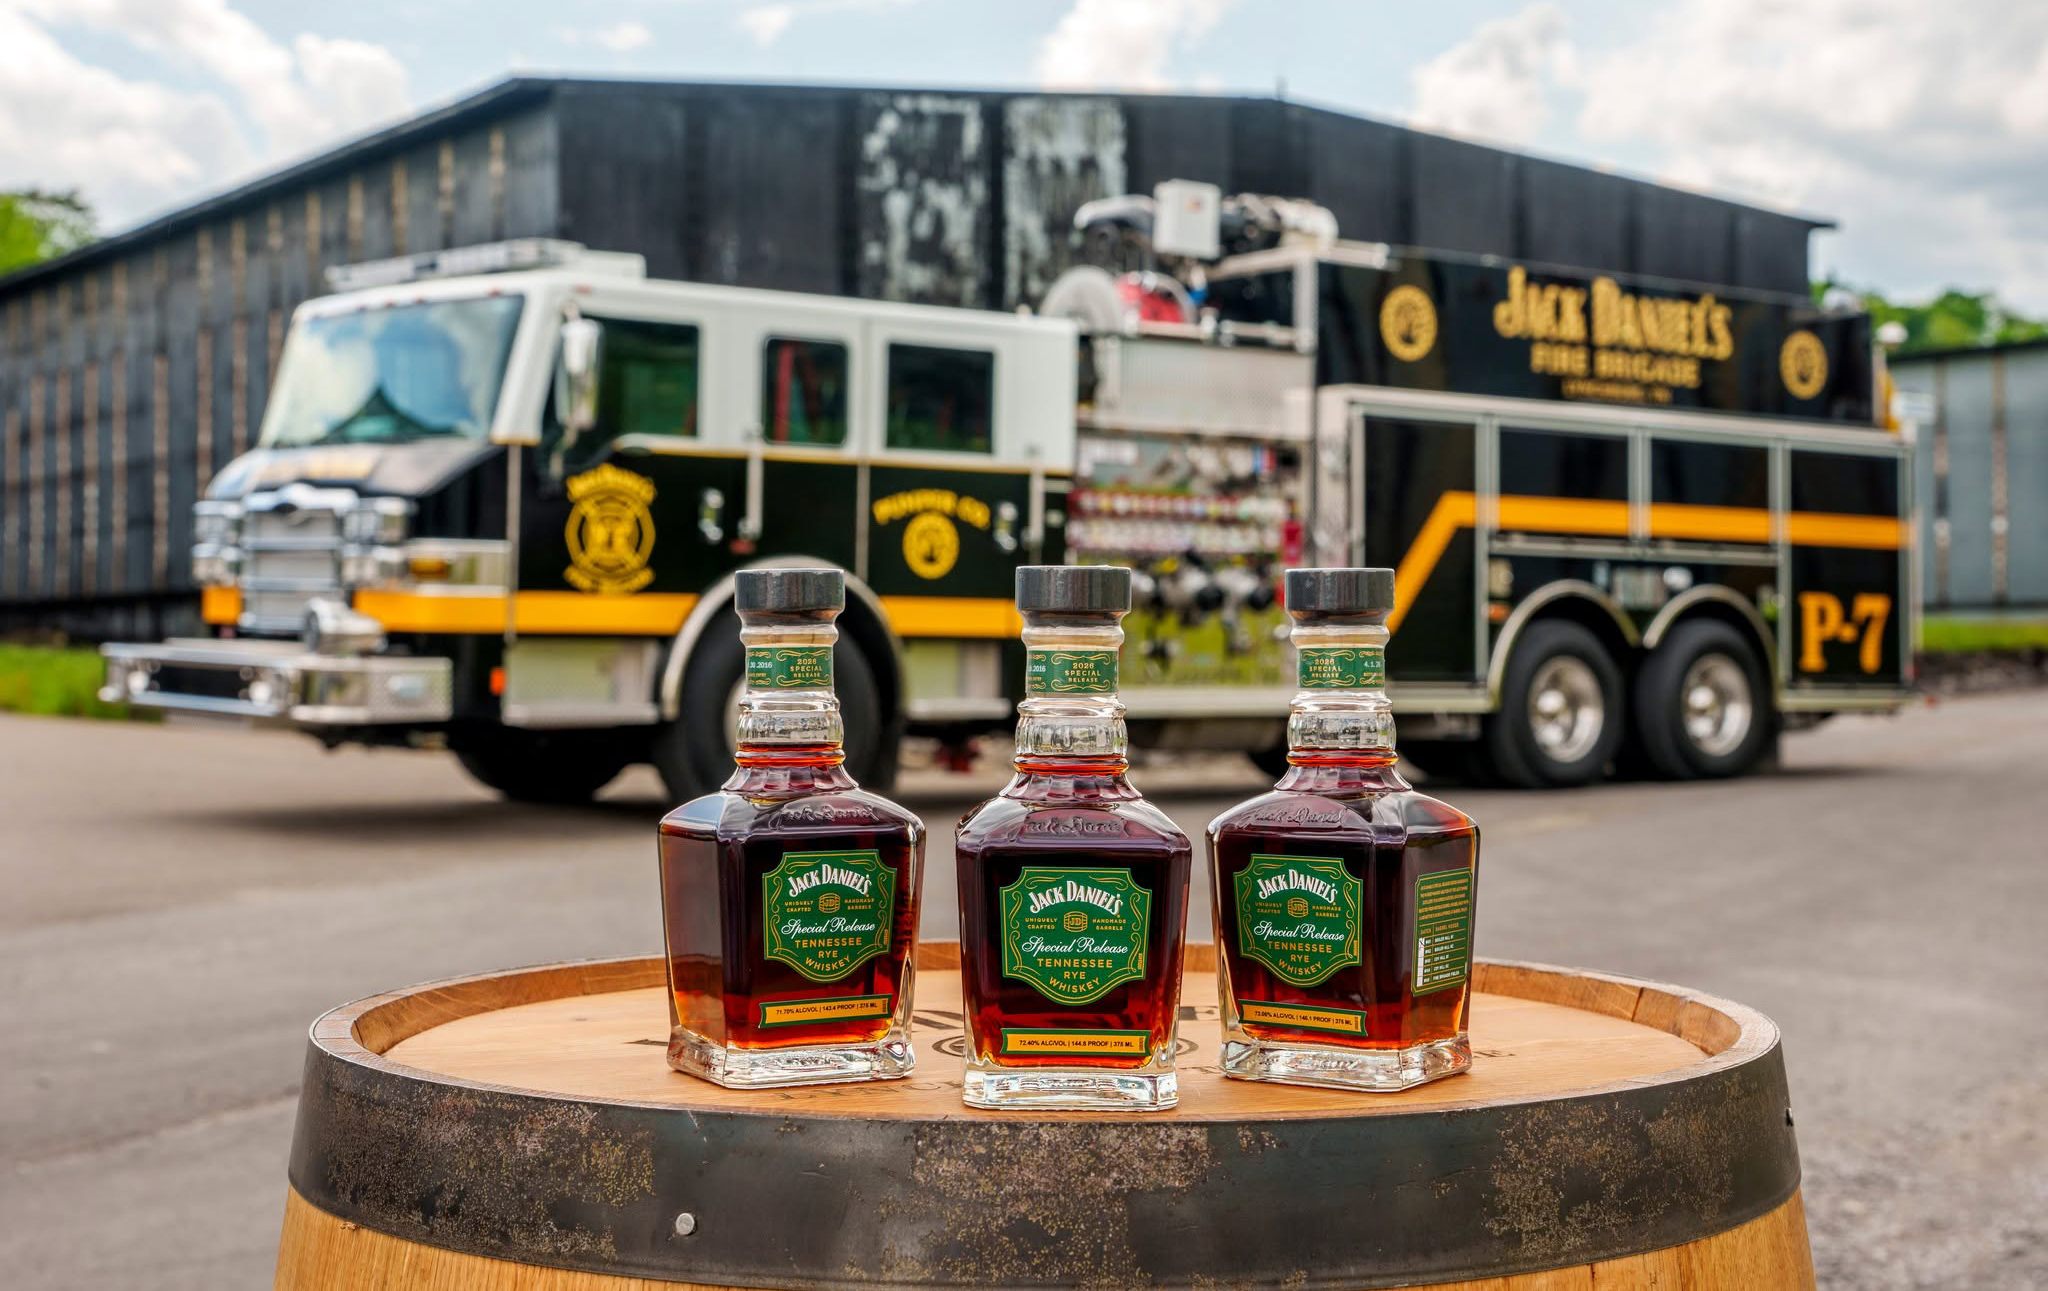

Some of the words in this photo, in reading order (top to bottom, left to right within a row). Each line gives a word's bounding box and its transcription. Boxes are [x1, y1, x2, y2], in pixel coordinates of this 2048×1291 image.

[1493, 265, 1587, 342] JACK
[1591, 276, 1733, 360] DANIEL'S
[1530, 342, 1588, 377] FIRE
[1594, 350, 1700, 389] BRIGADE
[1799, 591, 1891, 674] P-7
[788, 869, 820, 897] JACK
[821, 863, 872, 895] DANIEL'S
[1257, 874, 1289, 900] JACK
[1289, 868, 1338, 904] DANIEL'S
[1028, 885, 1066, 914] JACK
[1066, 880, 1123, 916] DANIEL'S
[781, 918, 828, 940] Special
[829, 917, 876, 933] Release
[1253, 920, 1300, 941] Special
[1300, 923, 1345, 941] Release
[794, 937, 862, 949] TENNESSEE
[1022, 935, 1076, 957] Special
[1076, 936, 1128, 954] Release
[1267, 941, 1332, 953] TENNESSEE
[805, 955, 851, 971] WHISKEY
[818, 950, 838, 959] RYE
[1037, 958, 1113, 968] TENNESSEE
[1290, 954, 1309, 963] RYE
[1063, 971, 1086, 979] RYE
[1278, 958, 1323, 976] WHISKEY
[1049, 976, 1101, 993] WHISKEY
[1273, 1012, 1295, 1020] ALC/VOL
